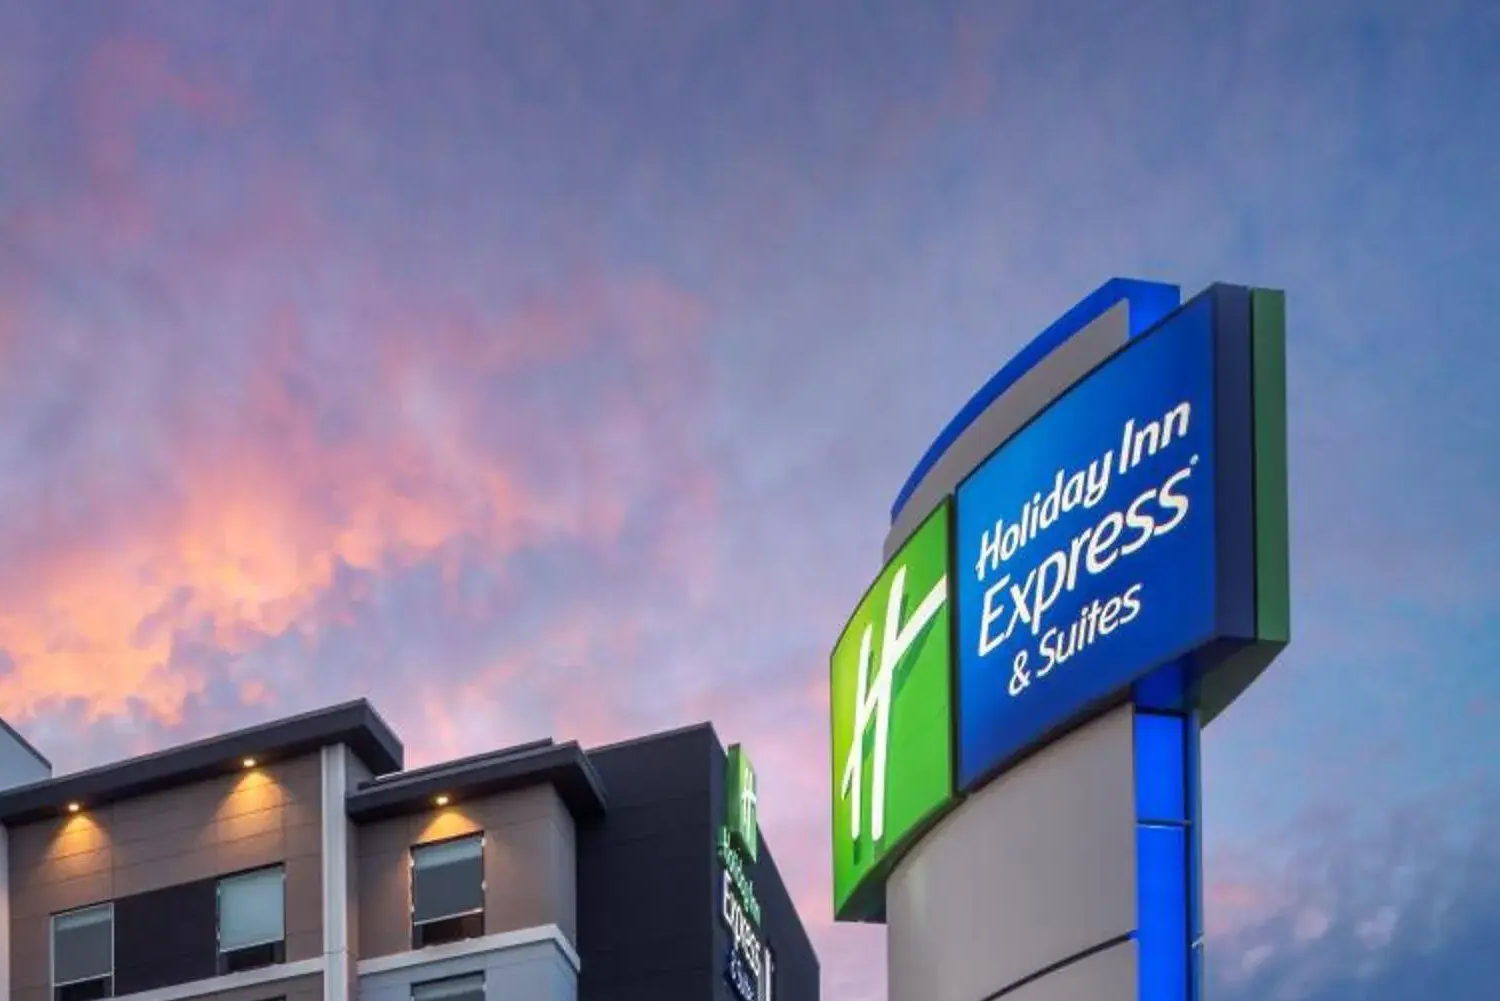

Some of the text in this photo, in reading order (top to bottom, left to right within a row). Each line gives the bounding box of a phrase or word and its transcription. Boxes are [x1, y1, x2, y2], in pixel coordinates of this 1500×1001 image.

[975, 401, 1192, 582] Holiday Inn
[978, 466, 1193, 658] Express
[1008, 582, 1143, 697] & Suites
